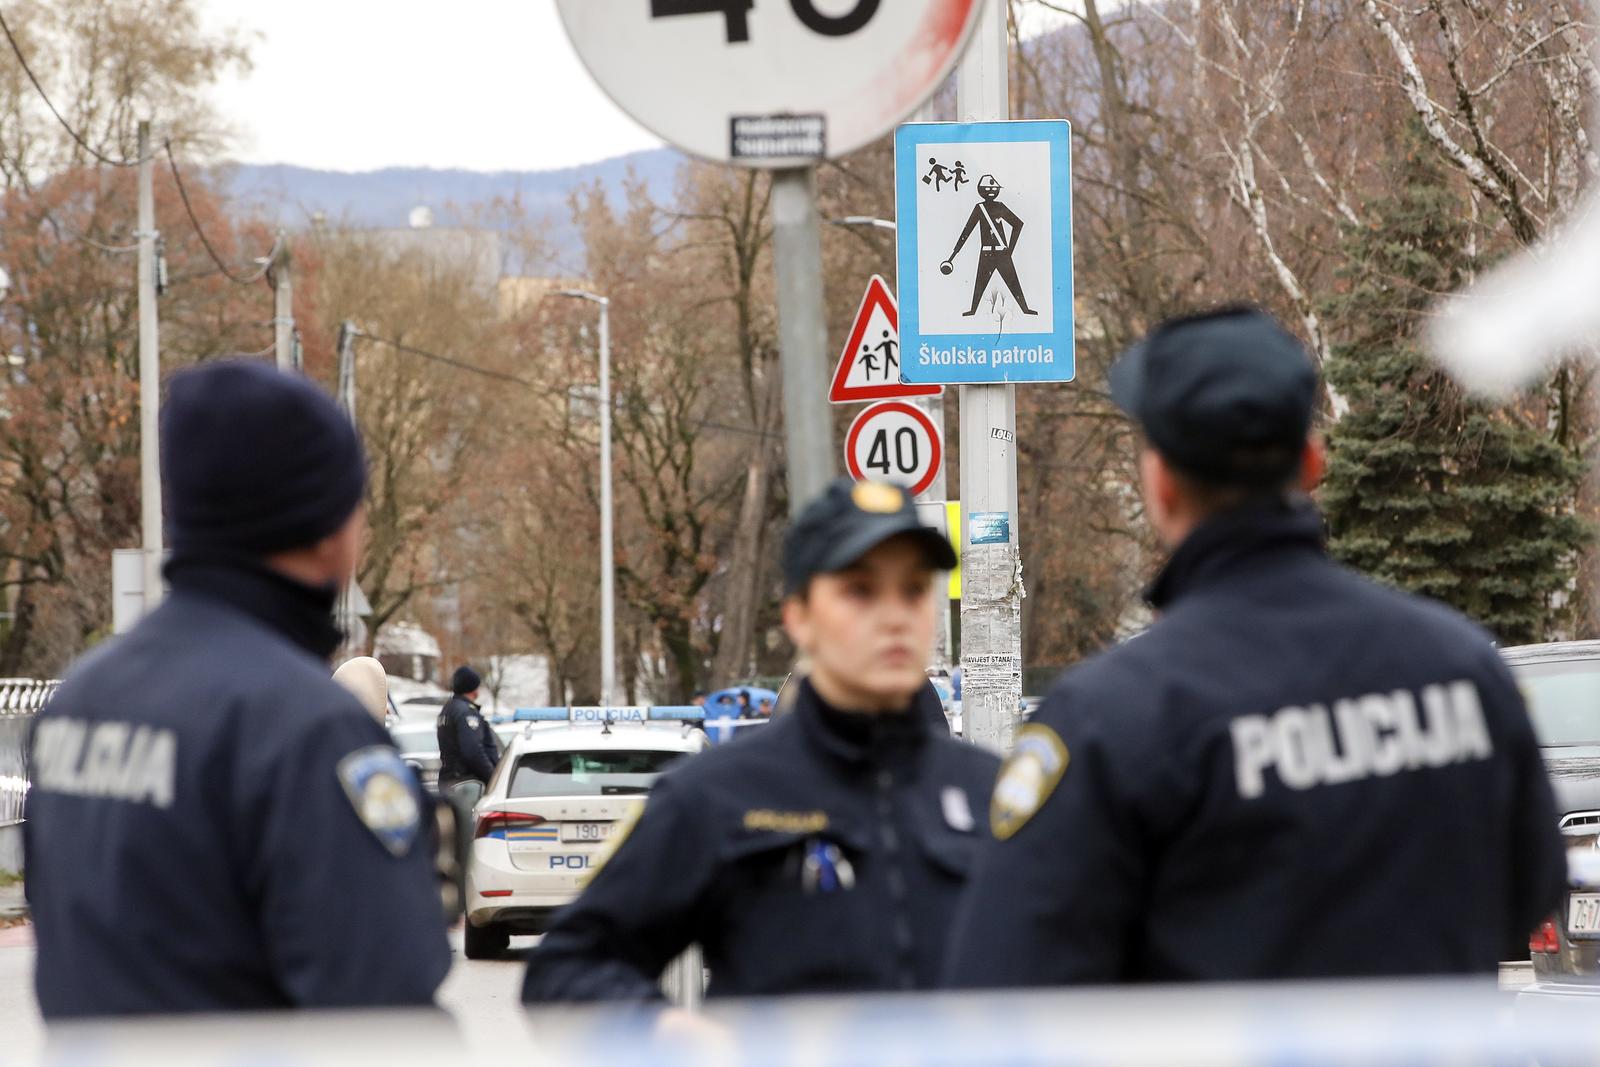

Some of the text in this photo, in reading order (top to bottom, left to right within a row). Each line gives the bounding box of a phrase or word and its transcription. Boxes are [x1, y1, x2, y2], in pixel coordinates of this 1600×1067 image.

[919, 343, 1054, 368] Školska patrola
[866, 426, 919, 474] 40
[574, 709, 642, 720] POLICIJA
[1230, 679, 1494, 799] POLICIJA
